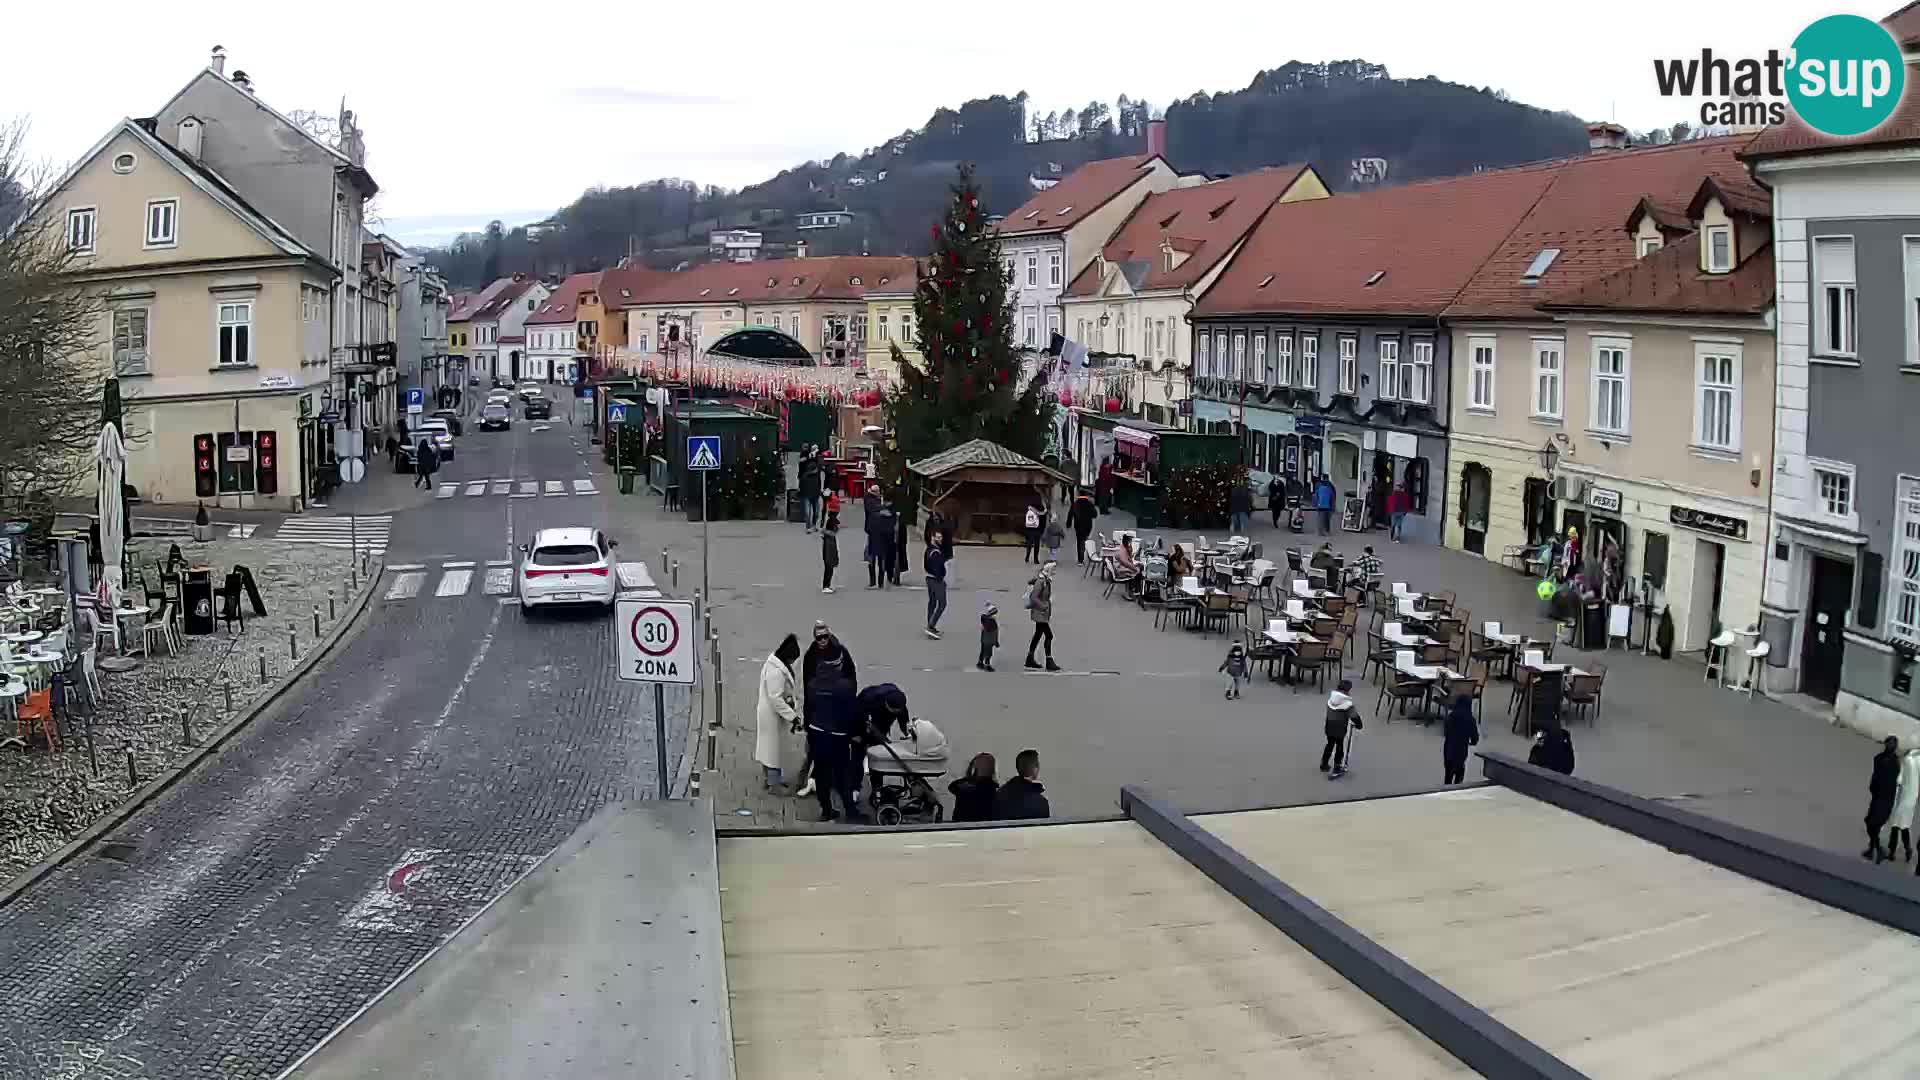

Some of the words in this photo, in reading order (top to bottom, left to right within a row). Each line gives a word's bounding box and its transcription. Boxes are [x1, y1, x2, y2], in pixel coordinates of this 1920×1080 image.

[411, 391, 420, 402] P
[644, 622, 668, 643] 30
[634, 659, 679, 676] ZONA
